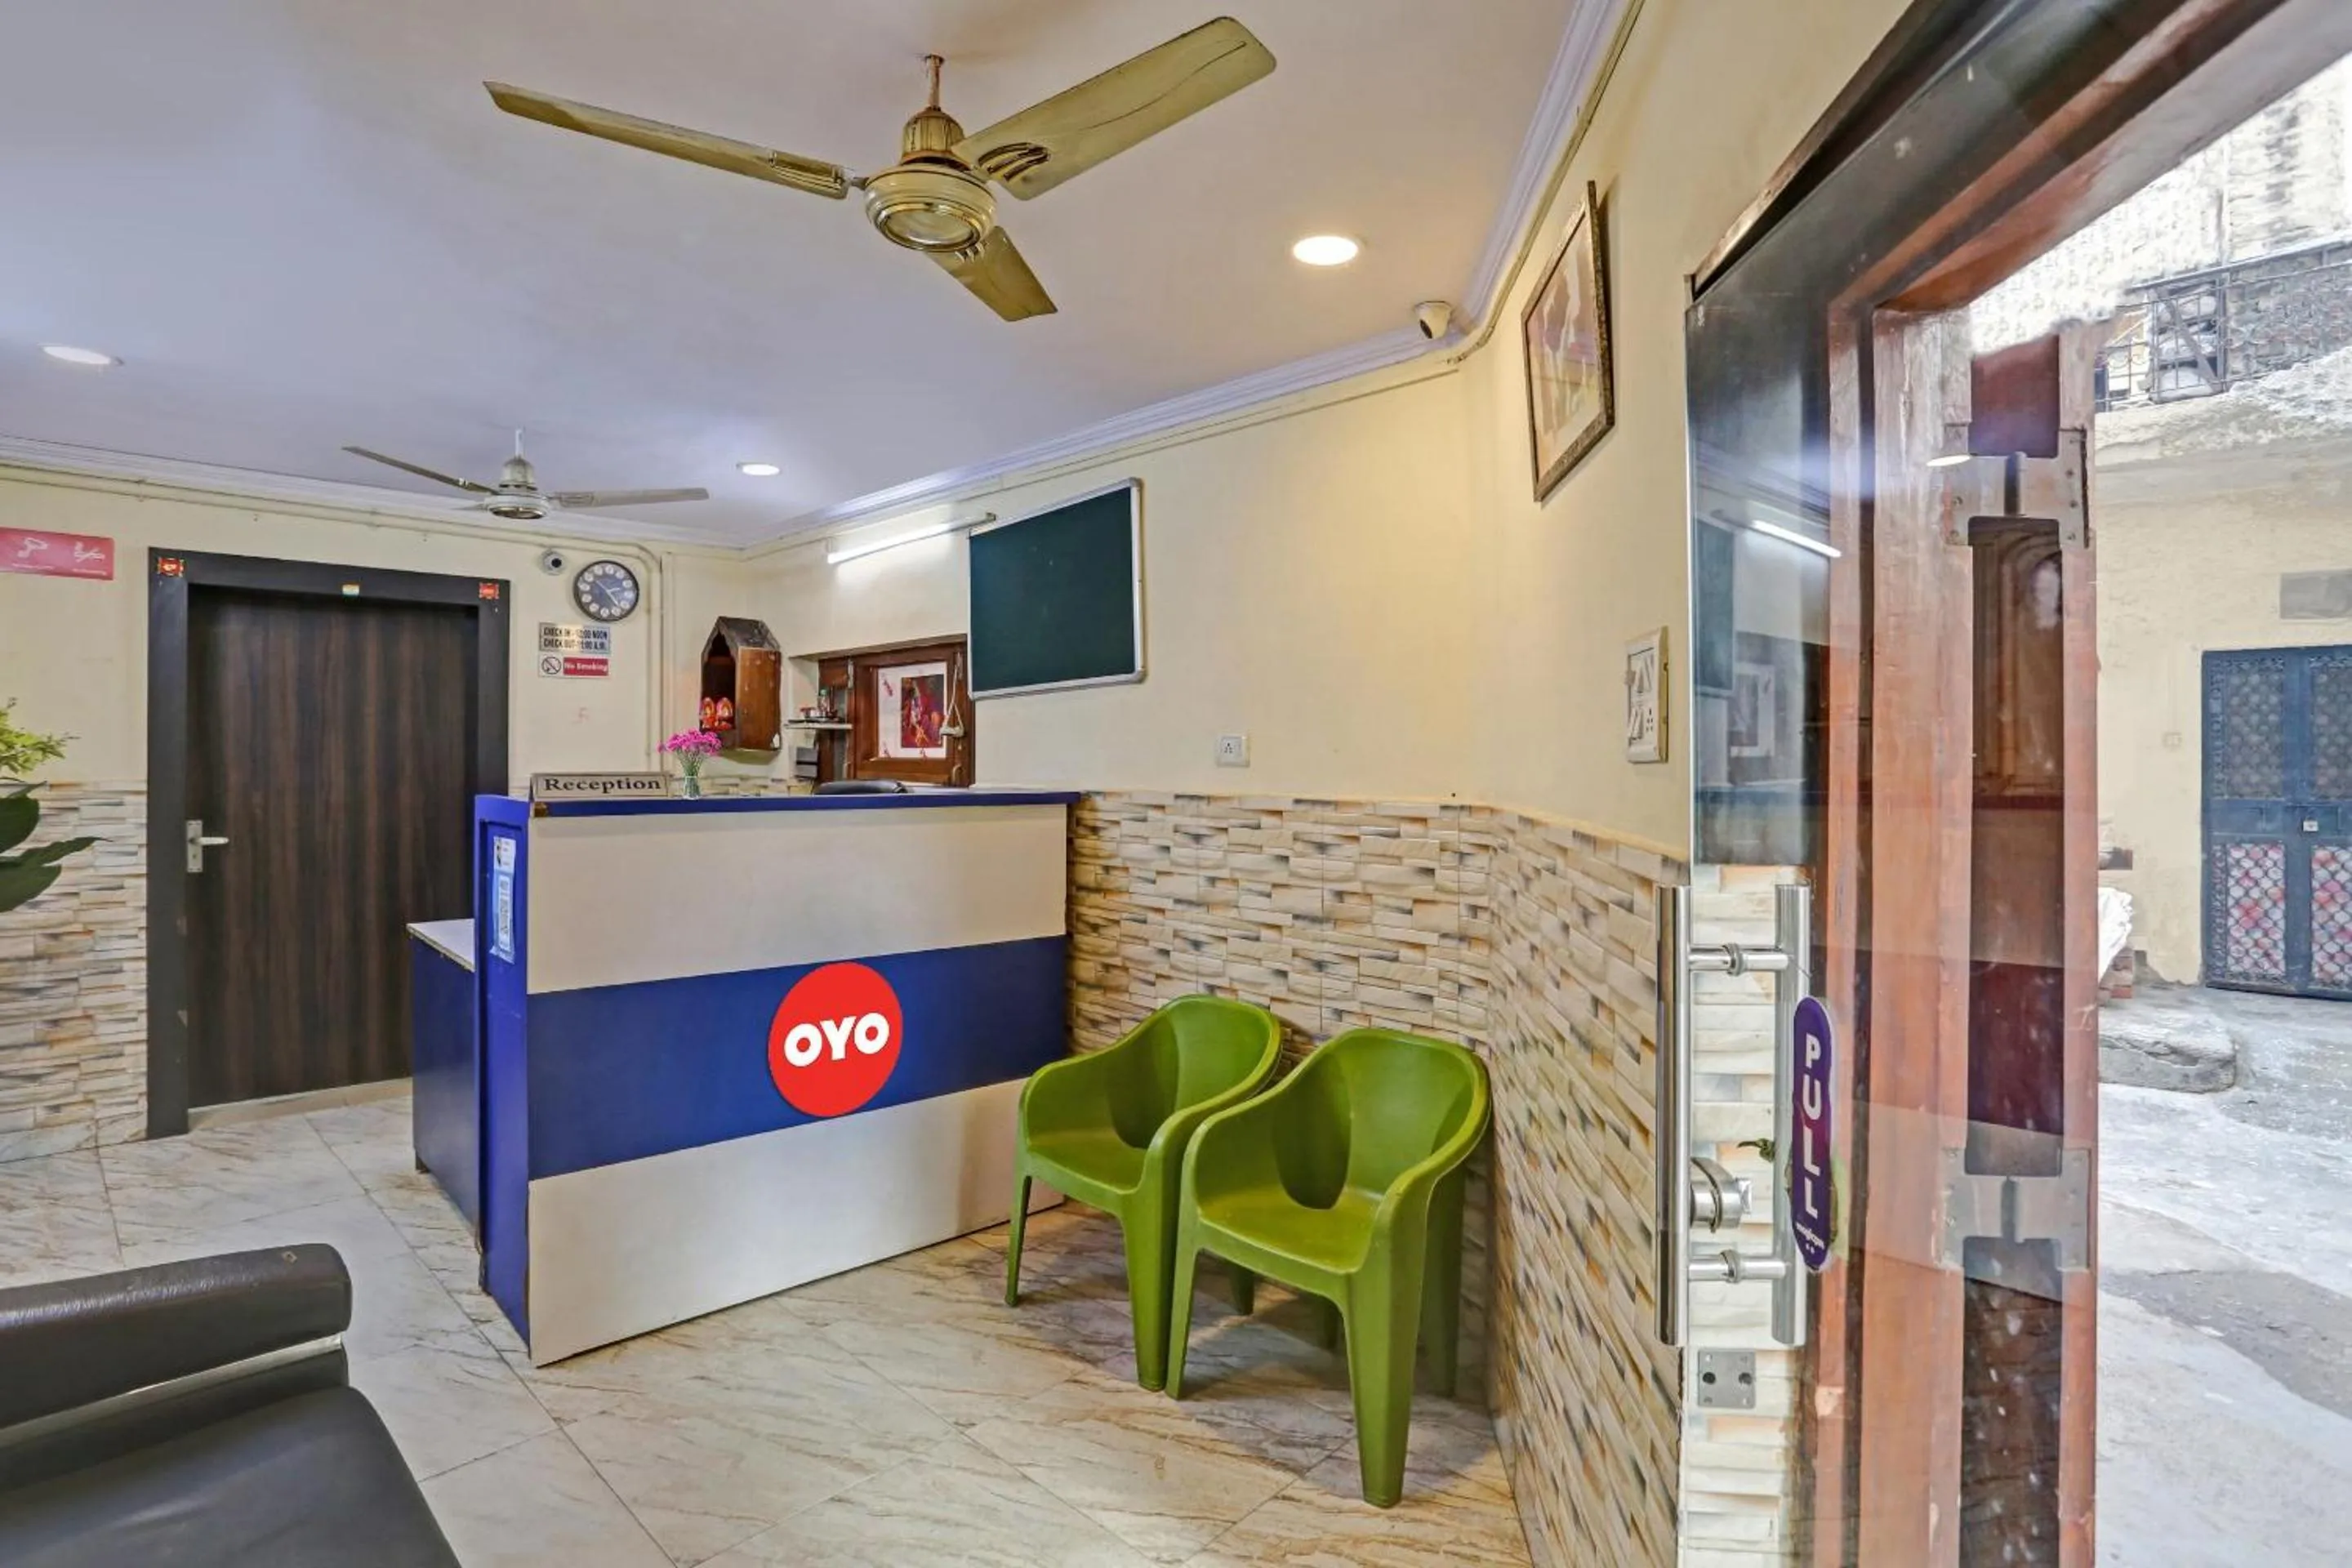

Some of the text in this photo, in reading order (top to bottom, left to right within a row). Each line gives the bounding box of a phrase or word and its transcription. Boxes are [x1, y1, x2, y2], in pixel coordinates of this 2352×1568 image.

[543, 627, 562, 636] CHECK
[543, 638, 563, 648] CHECK
[577, 662, 608, 672] Smoking
[545, 777, 662, 795] Reception
[783, 1012, 890, 1067] OYO
[1802, 1032, 1822, 1219] PULL
